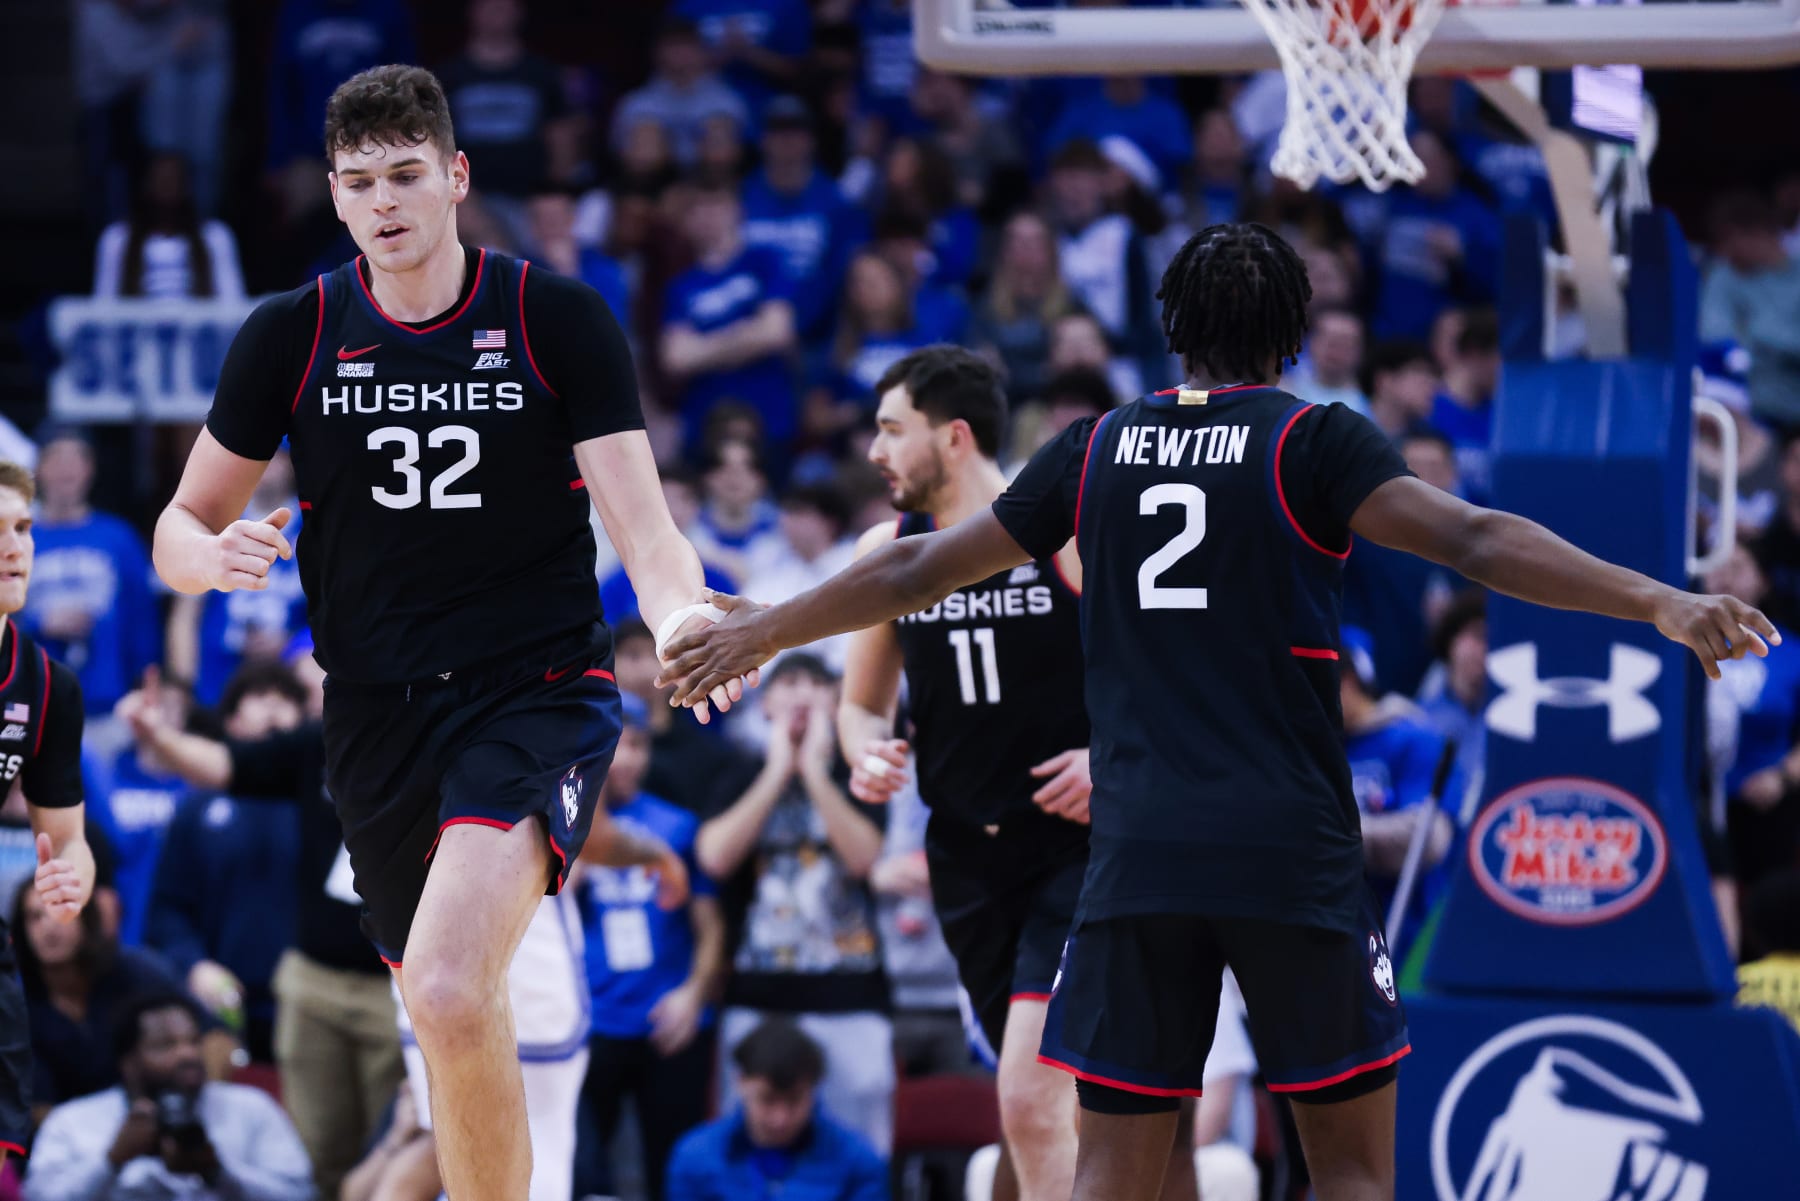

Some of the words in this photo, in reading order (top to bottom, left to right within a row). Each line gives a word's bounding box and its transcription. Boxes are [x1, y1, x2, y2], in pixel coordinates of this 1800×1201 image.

[475, 359, 511, 367] EAST
[479, 352, 504, 360] BIG
[321, 382, 524, 416] HUSKIES
[1114, 425, 1251, 467] NEWTON
[367, 424, 482, 510] 32
[1137, 483, 1208, 609] 2
[897, 585, 1053, 624] USKIES
[948, 627, 1001, 705] 11
